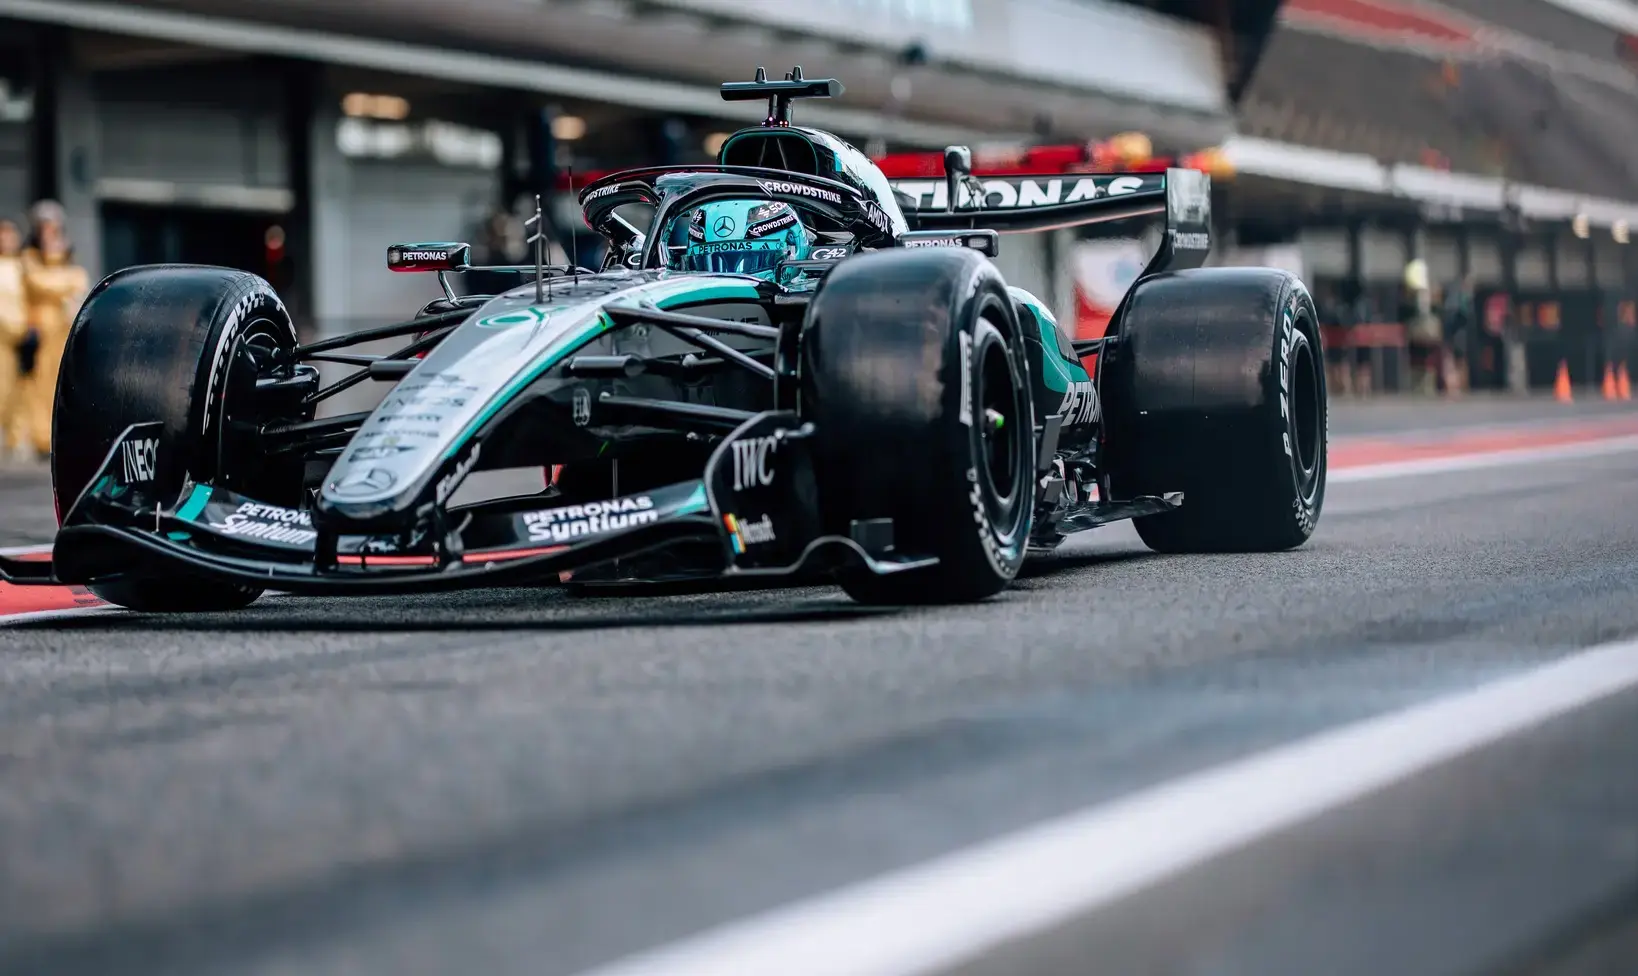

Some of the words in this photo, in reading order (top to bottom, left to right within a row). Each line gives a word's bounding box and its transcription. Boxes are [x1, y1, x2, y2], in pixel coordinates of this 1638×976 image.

[764, 181, 842, 204] CROWDSTRIKE
[699, 242, 753, 253] PETRONAS
[812, 248, 847, 260] G42
[905, 238, 963, 248] PETRONAS
[402, 251, 447, 261] PETRONAS
[1279, 312, 1293, 423] ZERO
[1282, 432, 1292, 458] P
[731, 435, 777, 491] IWC
[236, 502, 313, 526] PETRON
[522, 496, 654, 525] PETRONAS
[209, 514, 319, 545] Syntium
[526, 509, 659, 542] Syntium
